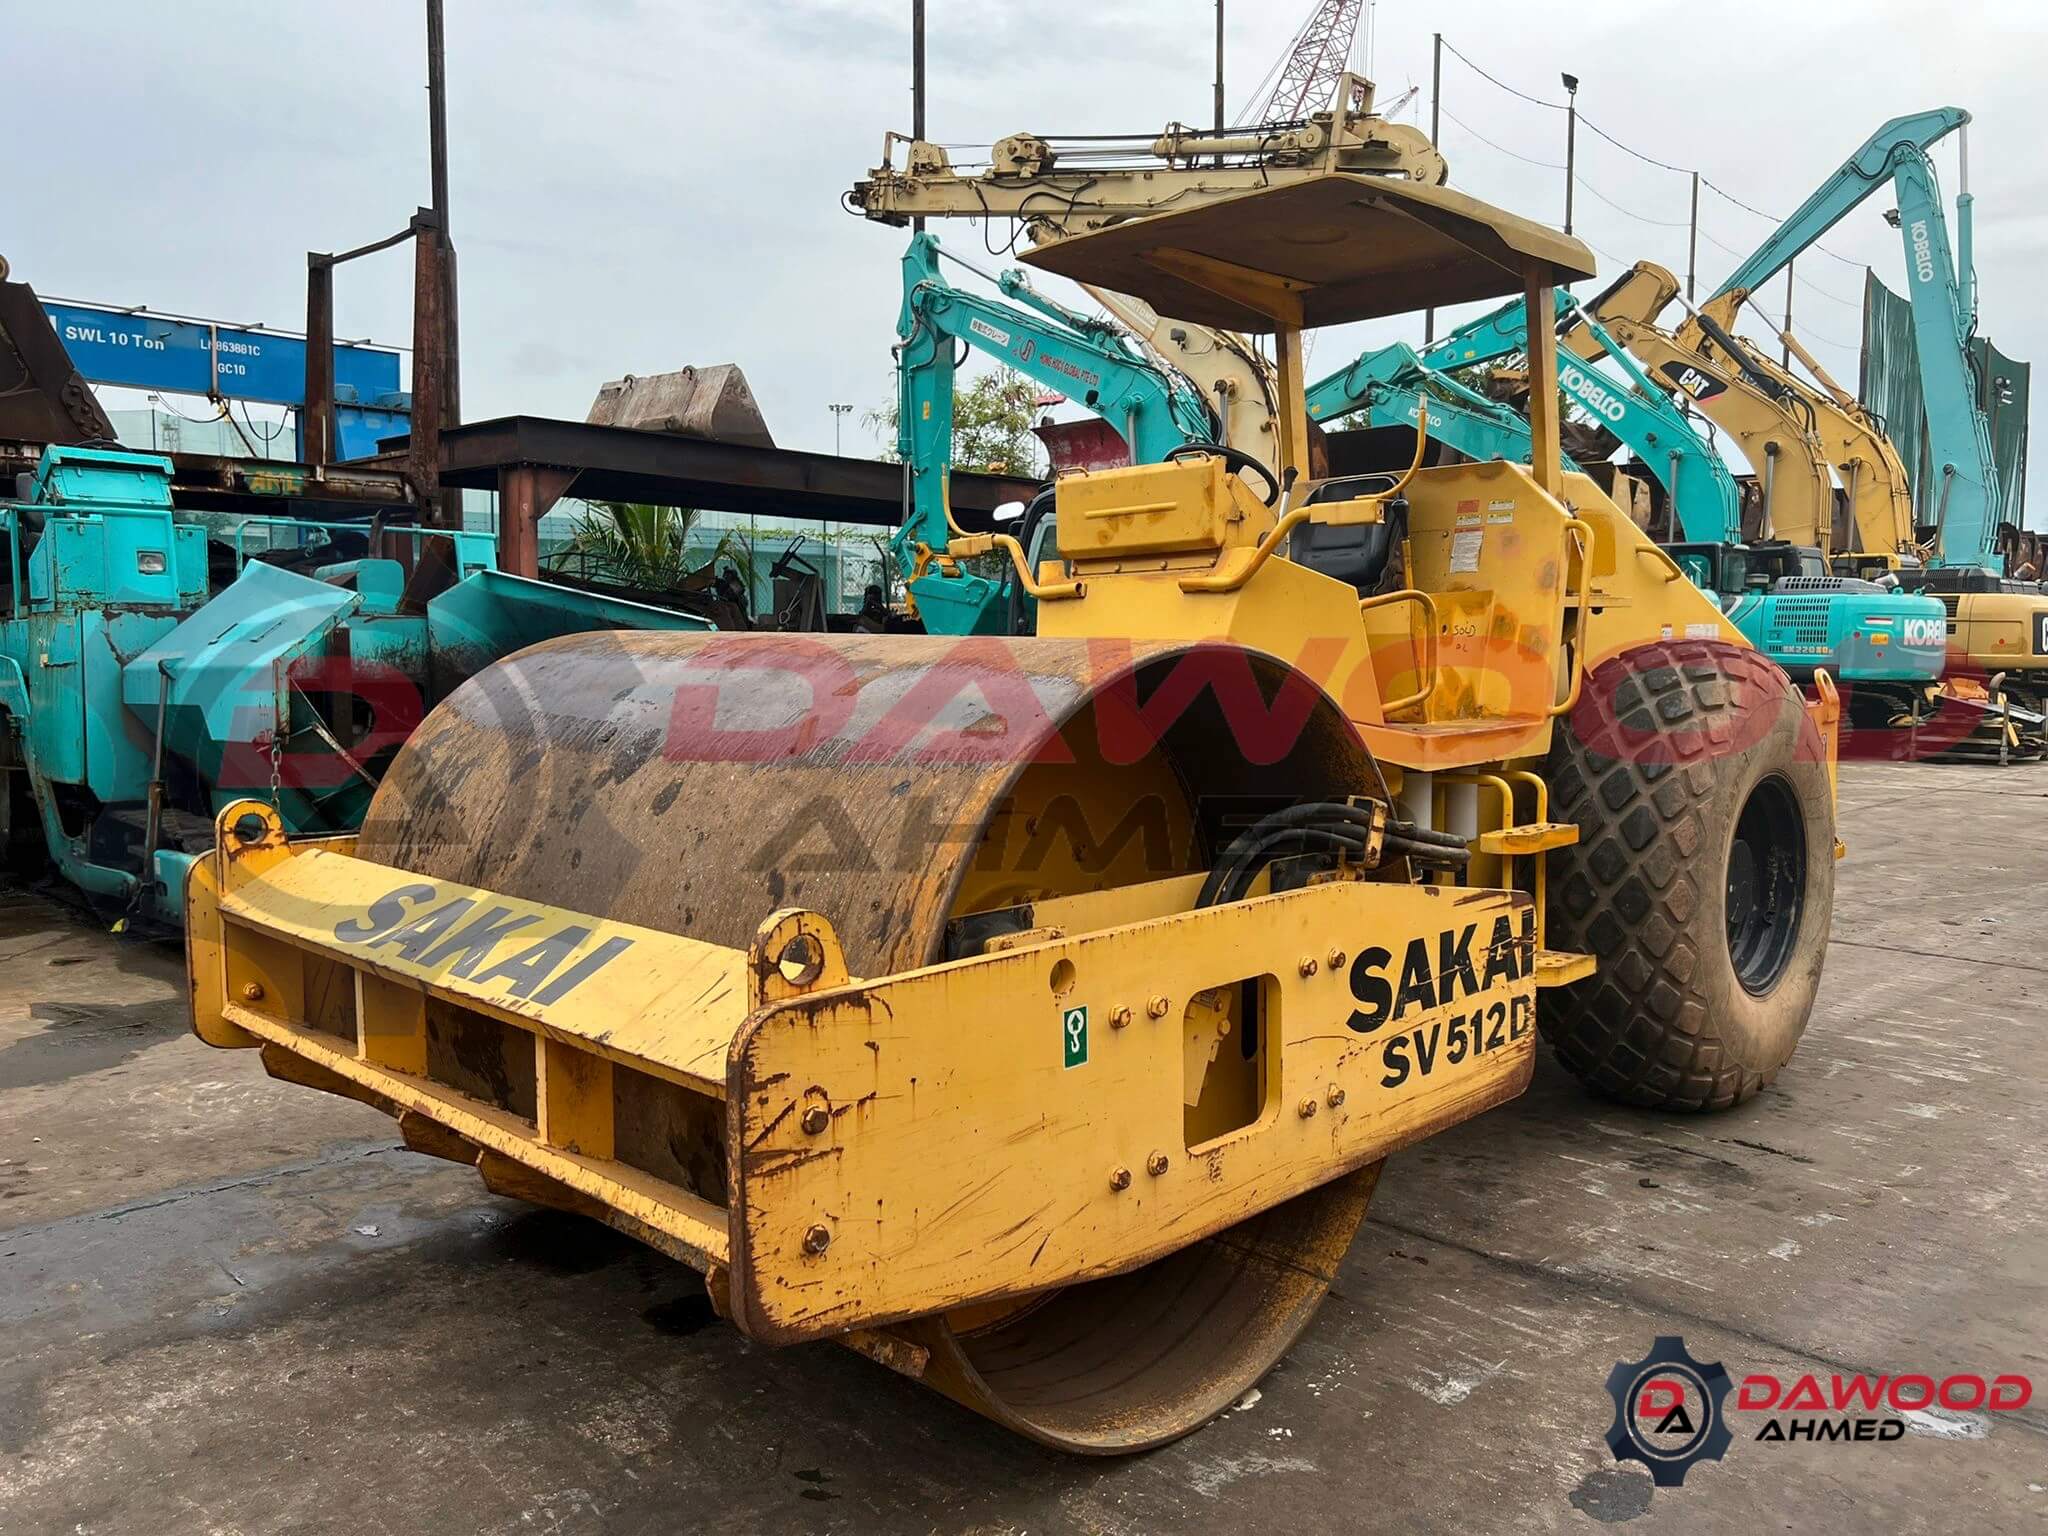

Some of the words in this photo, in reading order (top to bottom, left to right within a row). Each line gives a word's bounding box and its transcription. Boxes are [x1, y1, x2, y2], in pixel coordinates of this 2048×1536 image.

[1911, 220, 1934, 283] KOBELCO
[65, 326, 106, 343] SWL
[109, 332, 128, 345] 10
[131, 334, 165, 350] Ton
[217, 362, 246, 376] GC10
[1558, 364, 1625, 422] KOBELCO
[1678, 368, 1710, 397] CAT
[334, 883, 635, 1006] SAKAI
[1346, 909, 1535, 1034] SAKAI
[1380, 993, 1534, 1089] SV512D
